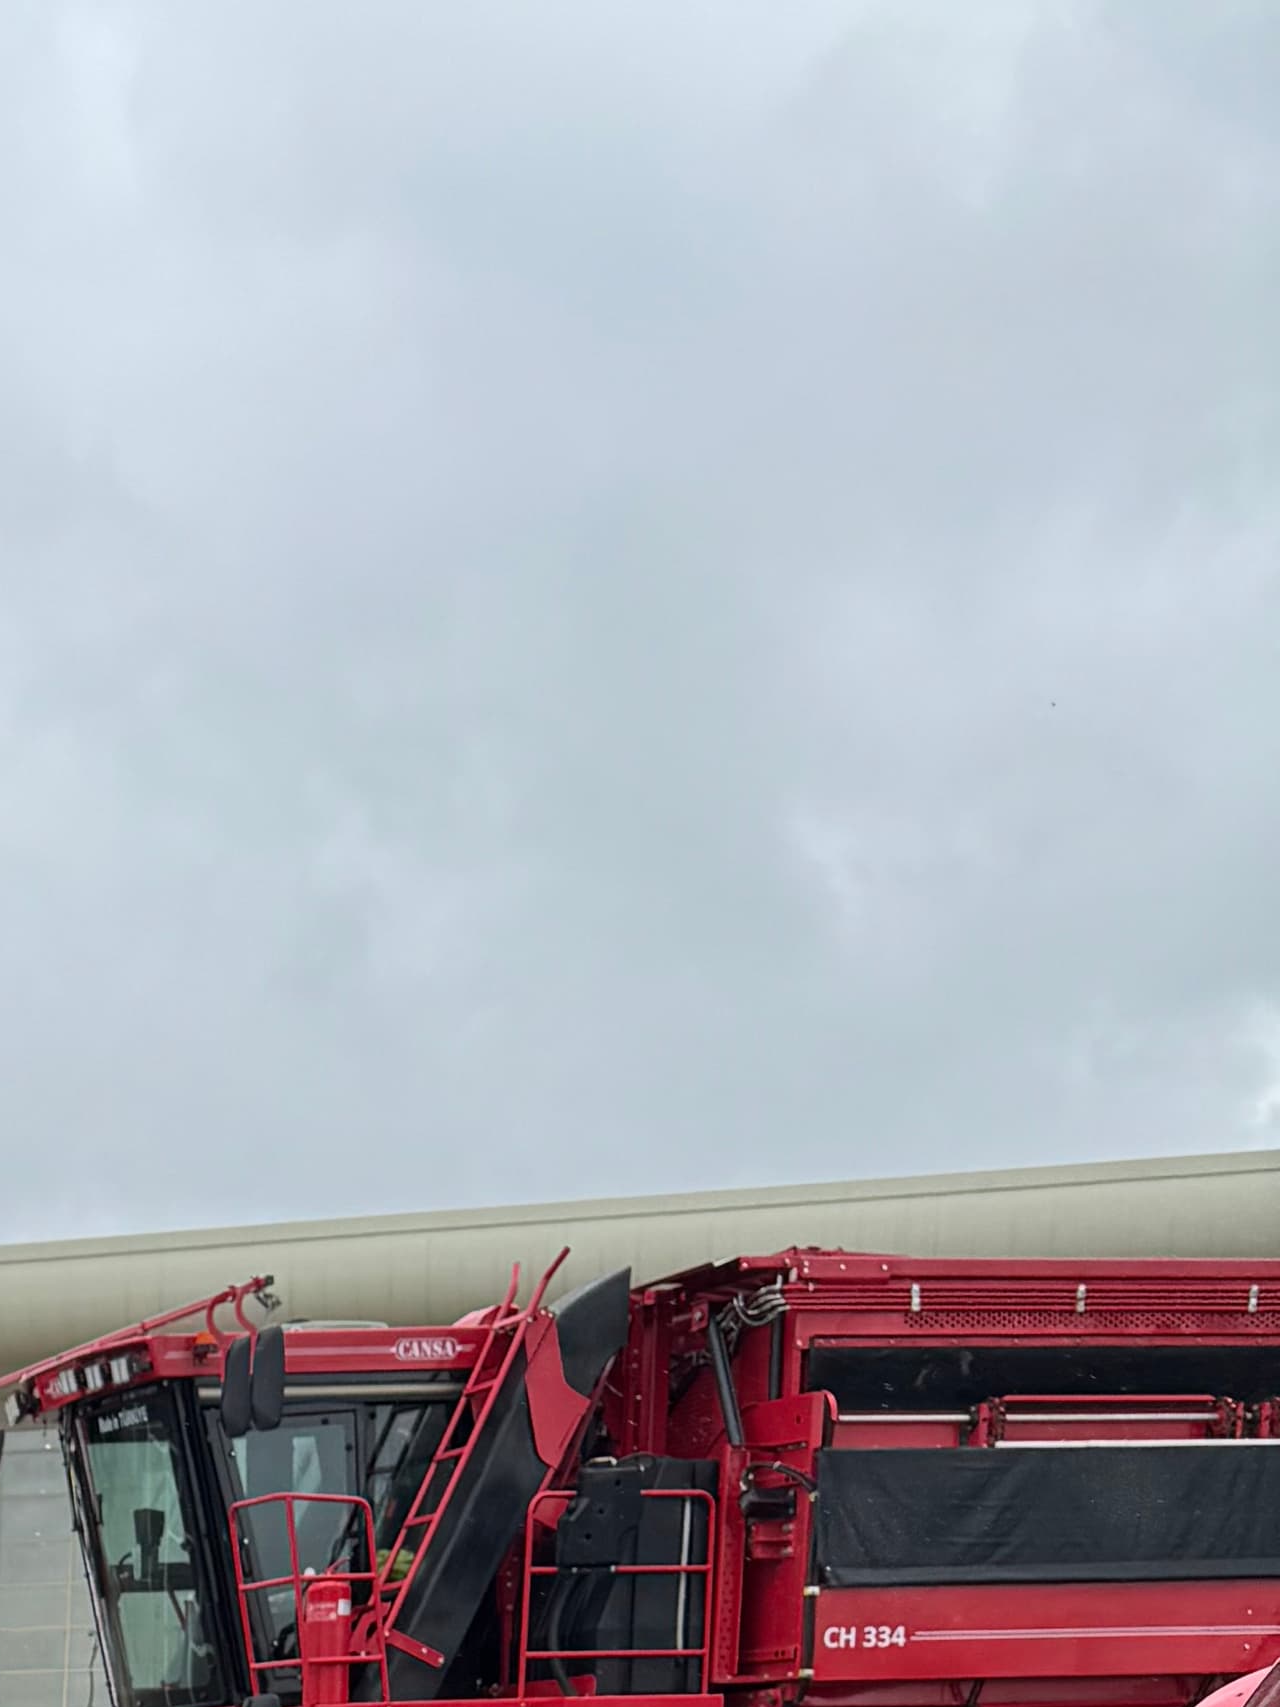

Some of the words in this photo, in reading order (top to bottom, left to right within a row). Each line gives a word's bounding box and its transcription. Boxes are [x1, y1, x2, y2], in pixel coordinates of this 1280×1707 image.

[399, 1340, 454, 1358] CANSA
[823, 1626, 857, 1648] CH
[862, 1625, 907, 1648] 334
